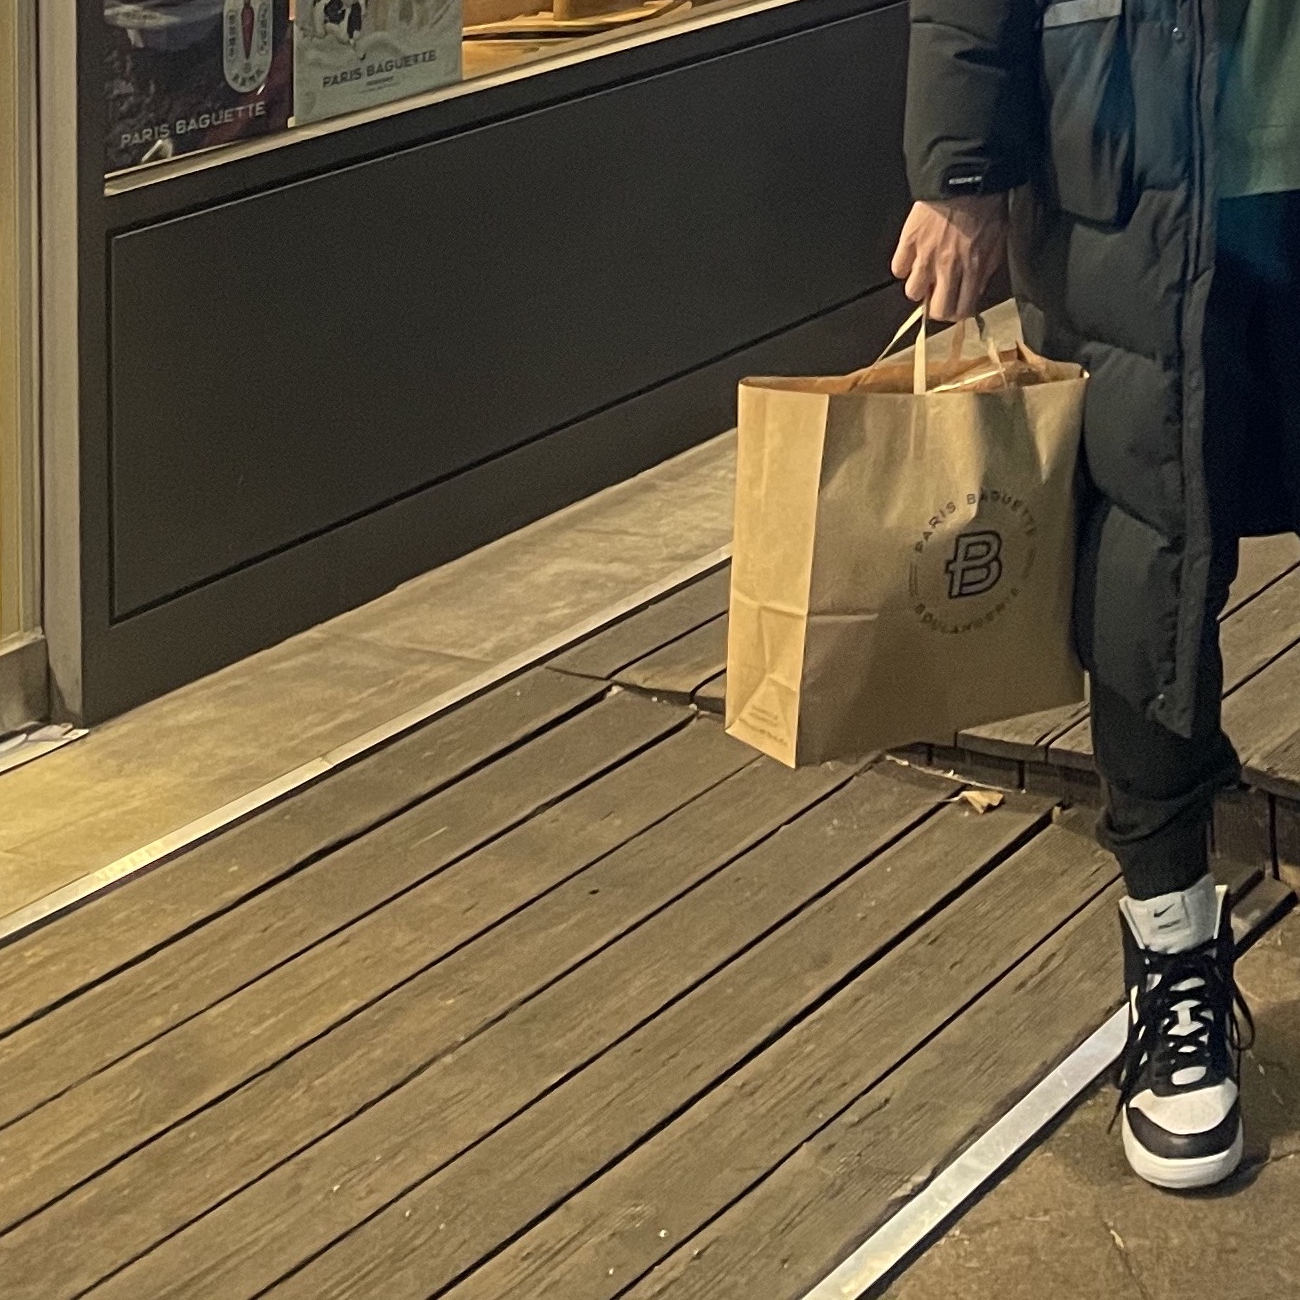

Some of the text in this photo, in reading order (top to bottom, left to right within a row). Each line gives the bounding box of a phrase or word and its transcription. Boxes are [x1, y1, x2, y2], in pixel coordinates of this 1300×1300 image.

[322, 66, 363, 89] PARIS
[365, 49, 437, 78] BAGUETTE
[120, 101, 268, 149] PARIS BAGUETTE
[914, 501, 957, 554] PARIS
